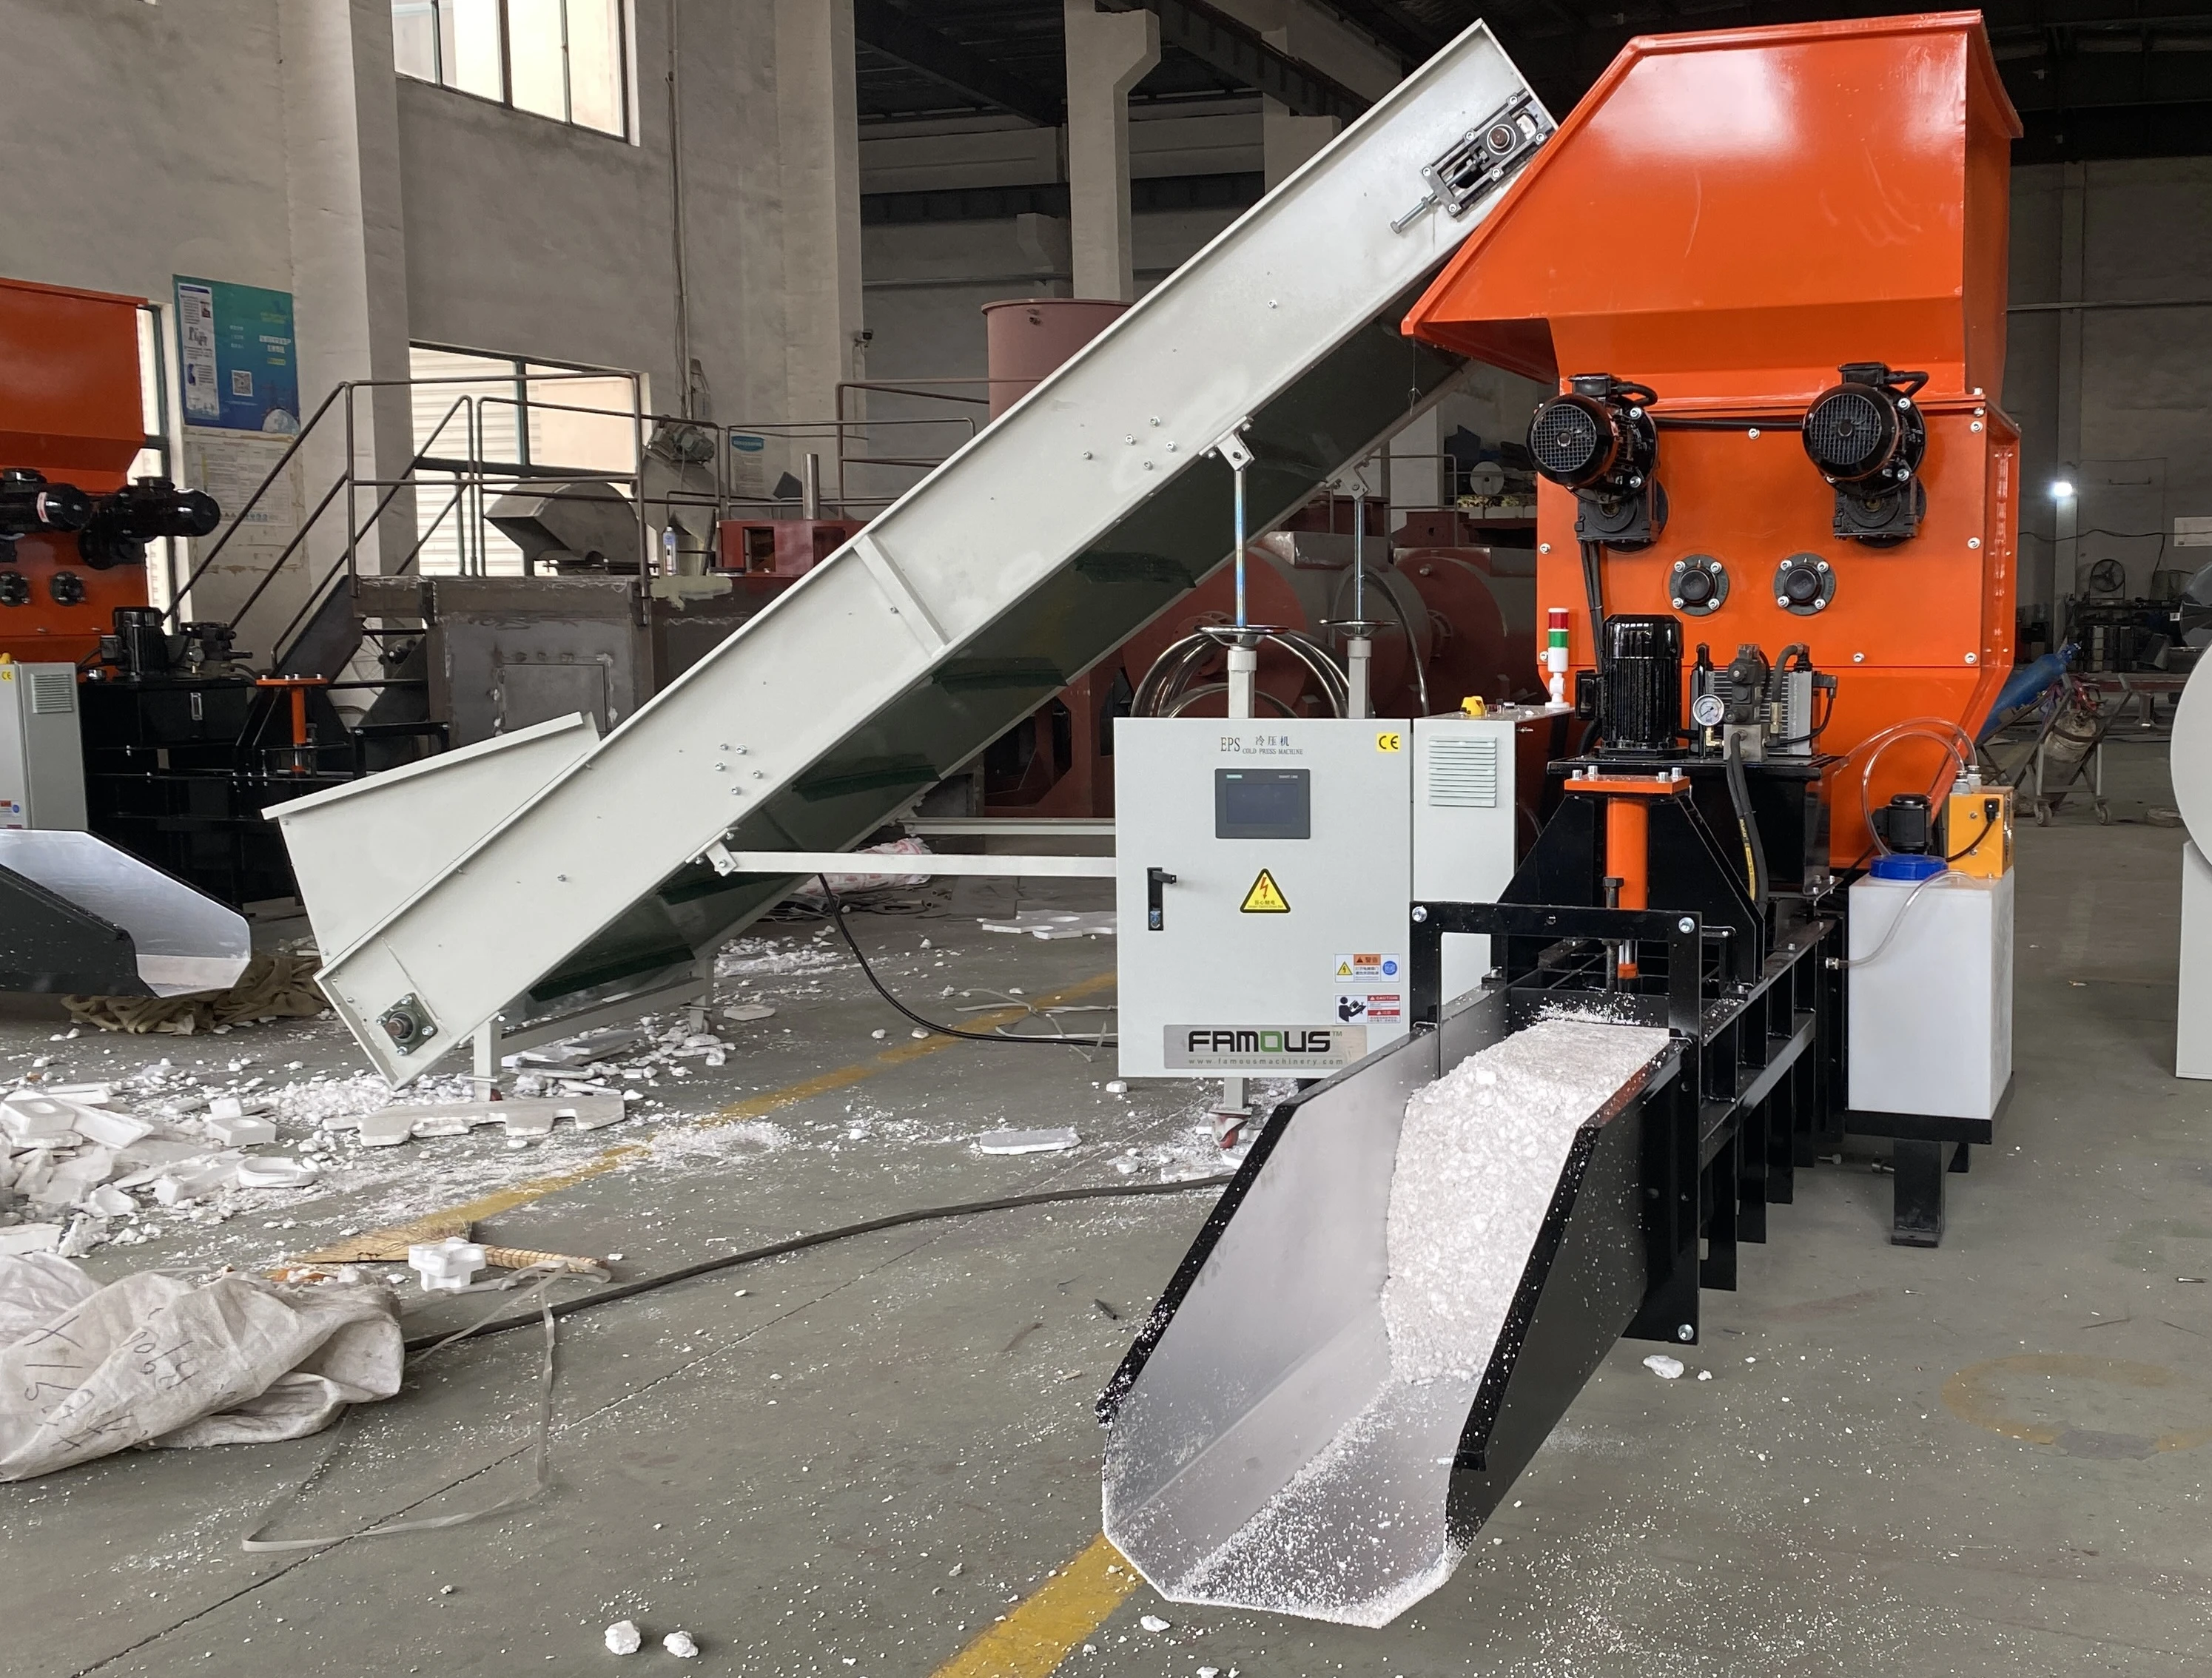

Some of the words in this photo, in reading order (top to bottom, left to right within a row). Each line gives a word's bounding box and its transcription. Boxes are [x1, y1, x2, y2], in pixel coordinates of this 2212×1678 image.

[1, 671, 12, 680] CE
[1220, 737, 1240, 752] EPS
[1255, 735, 1289, 747] 冷压机
[1379, 735, 1399, 749] CE
[1189, 1031, 1331, 1052] FAMOUS
[1189, 1057, 1343, 1065] www.famousmachinery.com
